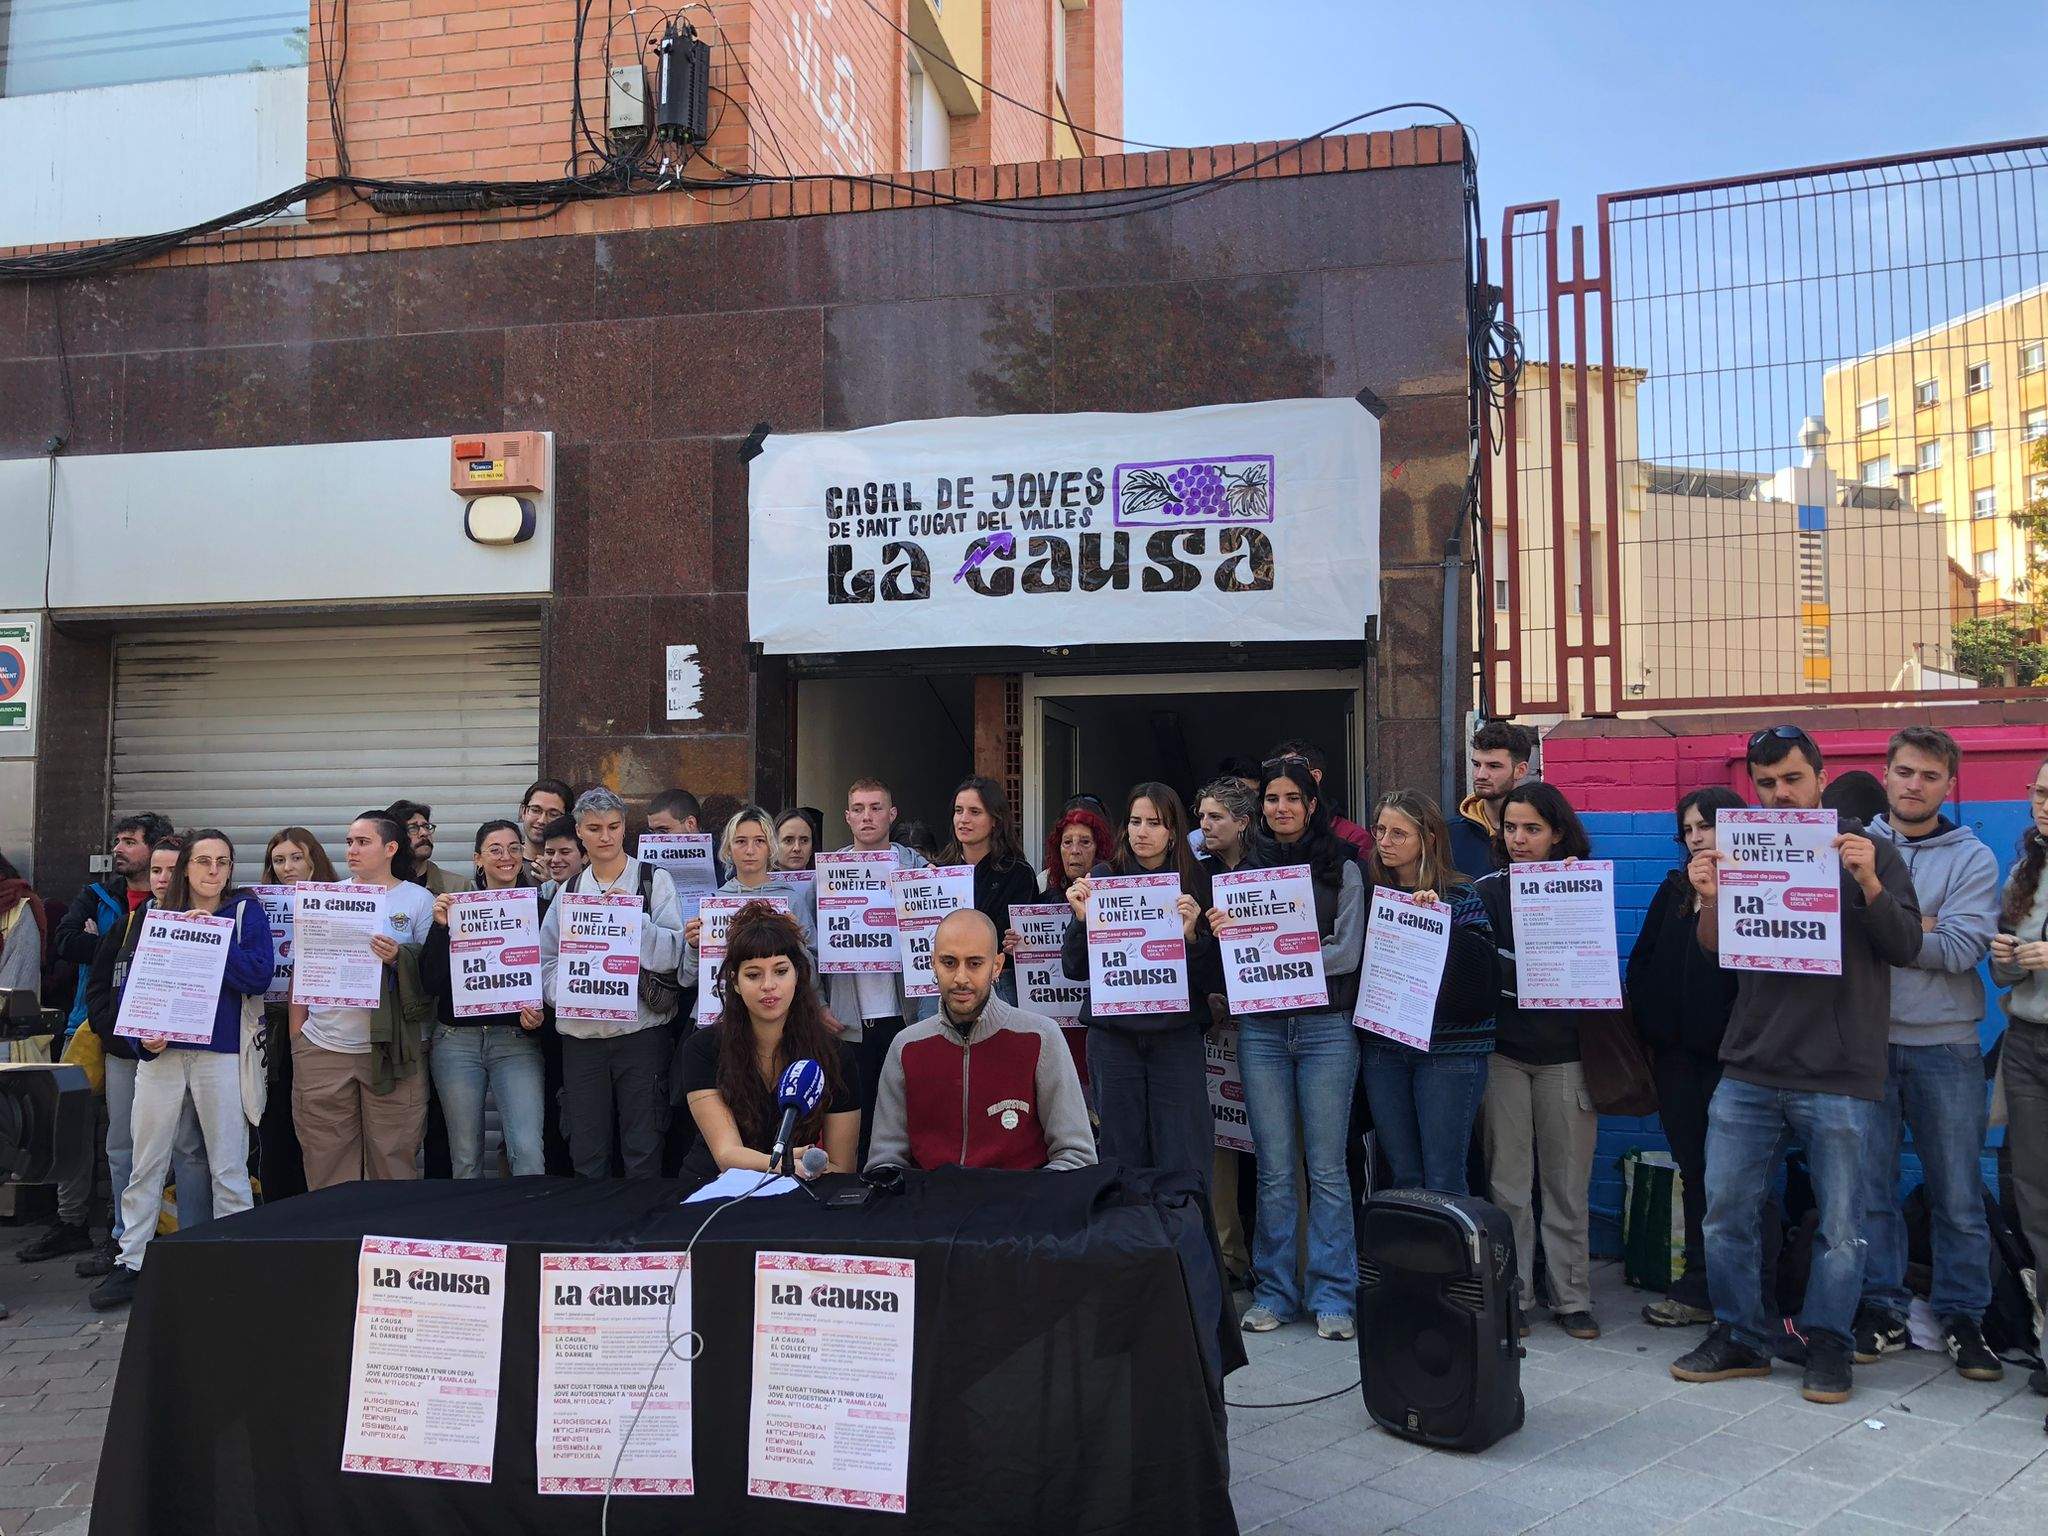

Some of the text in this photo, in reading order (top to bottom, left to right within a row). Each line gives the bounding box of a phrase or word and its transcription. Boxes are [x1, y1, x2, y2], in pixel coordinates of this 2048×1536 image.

[825, 467, 1105, 519] CASAL DE JOVES
[828, 521, 851, 539] DE
[857, 517, 902, 538] SANT
[908, 512, 968, 536] CUGAT
[977, 510, 1013, 532] DEL
[1732, 833, 1793, 846] VINE A
[1732, 847, 1815, 863] CONÈIXER
[828, 869, 872, 879] VINE A
[902, 885, 944, 898] VINE A
[1226, 889, 1277, 904] VINE A
[1098, 895, 1147, 909] VINE A
[460, 907, 506, 921] VINE A
[572, 911, 614, 923] VINE A
[711, 915, 734, 926] VIN
[1022, 921, 1055, 933] VINE
[1023, 932, 1064, 946] CONÈIX
